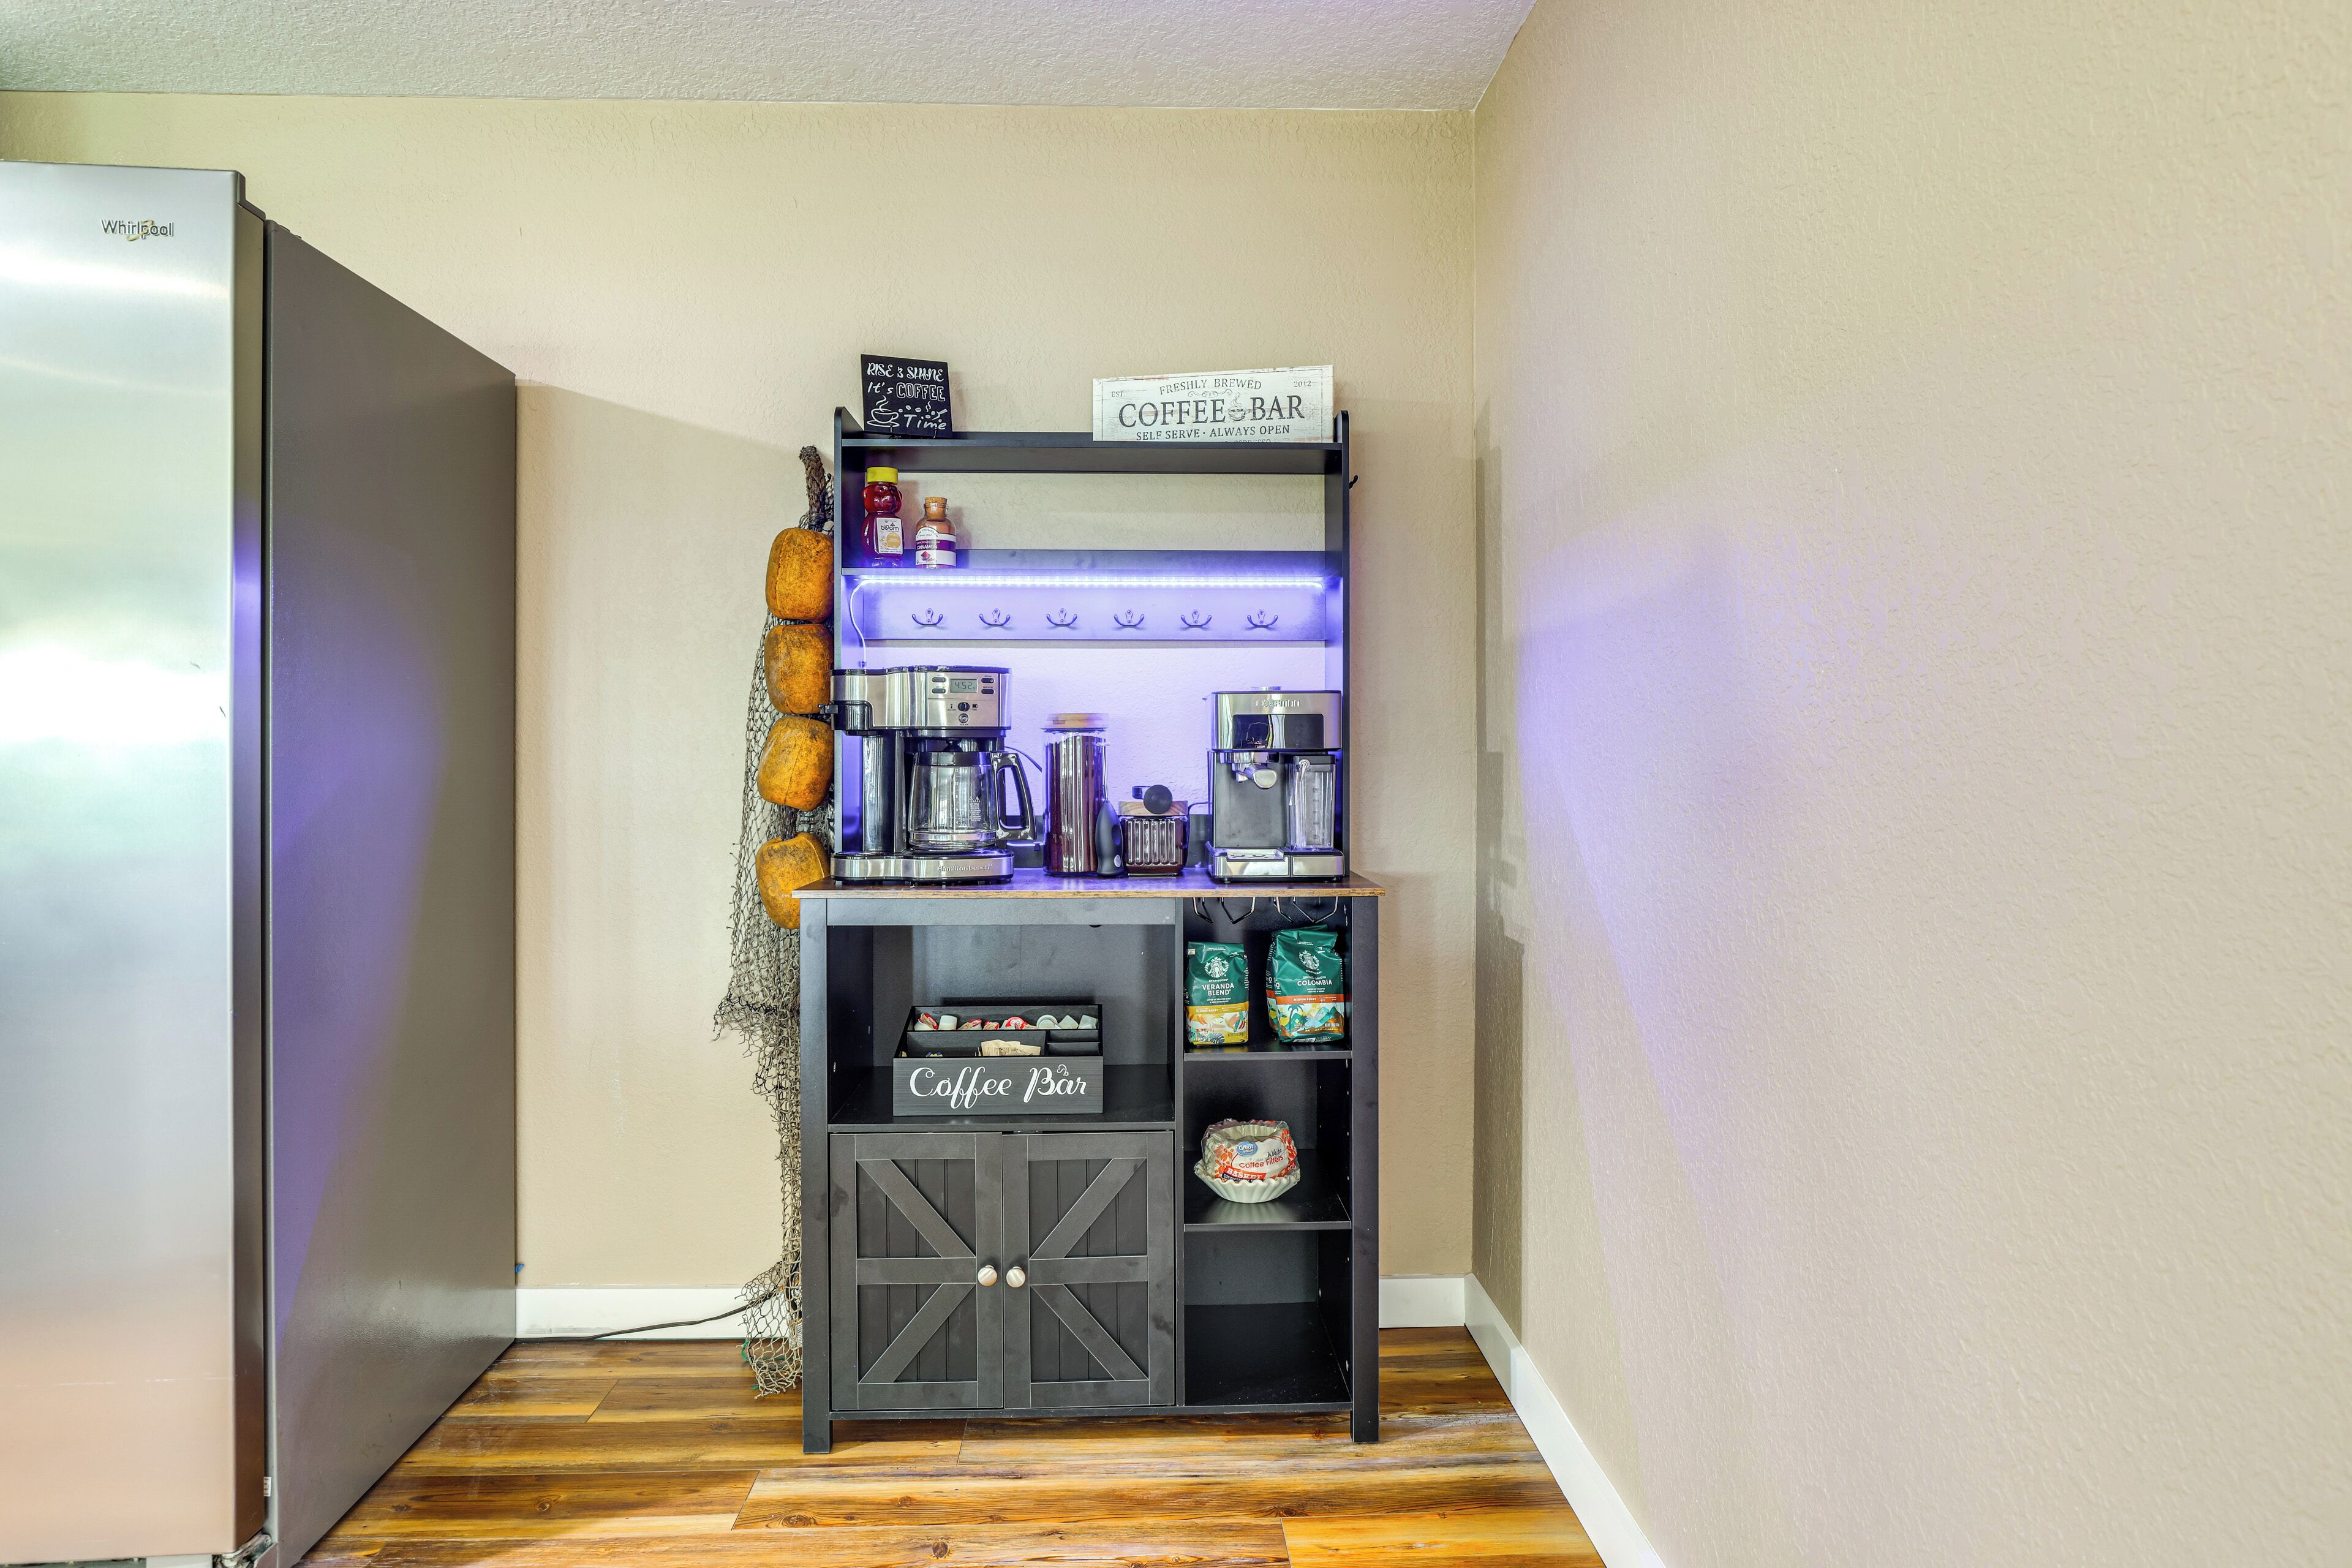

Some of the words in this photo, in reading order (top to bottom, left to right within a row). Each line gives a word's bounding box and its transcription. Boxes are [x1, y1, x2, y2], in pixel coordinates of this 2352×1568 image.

[101, 219, 174, 239] Whirlpool
[867, 362, 894, 378] RISE
[907, 366, 944, 382] SHINE
[867, 382, 894, 394] It's
[896, 382, 946, 402] COFFEE
[1159, 379, 1208, 396] FRESHLY
[1214, 378, 1262, 390] BREWED
[1118, 398, 1226, 428] COFFEE
[1250, 394, 1305, 421] BAR
[903, 414, 947, 430] Time
[1136, 431, 1162, 441] SELF
[1165, 429, 1200, 439] SERVE
[1209, 426, 1256, 437] ALWAYS
[1259, 424, 1290, 435] OPEN
[910, 1066, 1012, 1109] Coffee
[1023, 1067, 1087, 1103] Bar
[1265, 1155, 1284, 1166] Filters
[1267, 1148, 1282, 1158] White
[1226, 1167, 1262, 1179] BASKET
